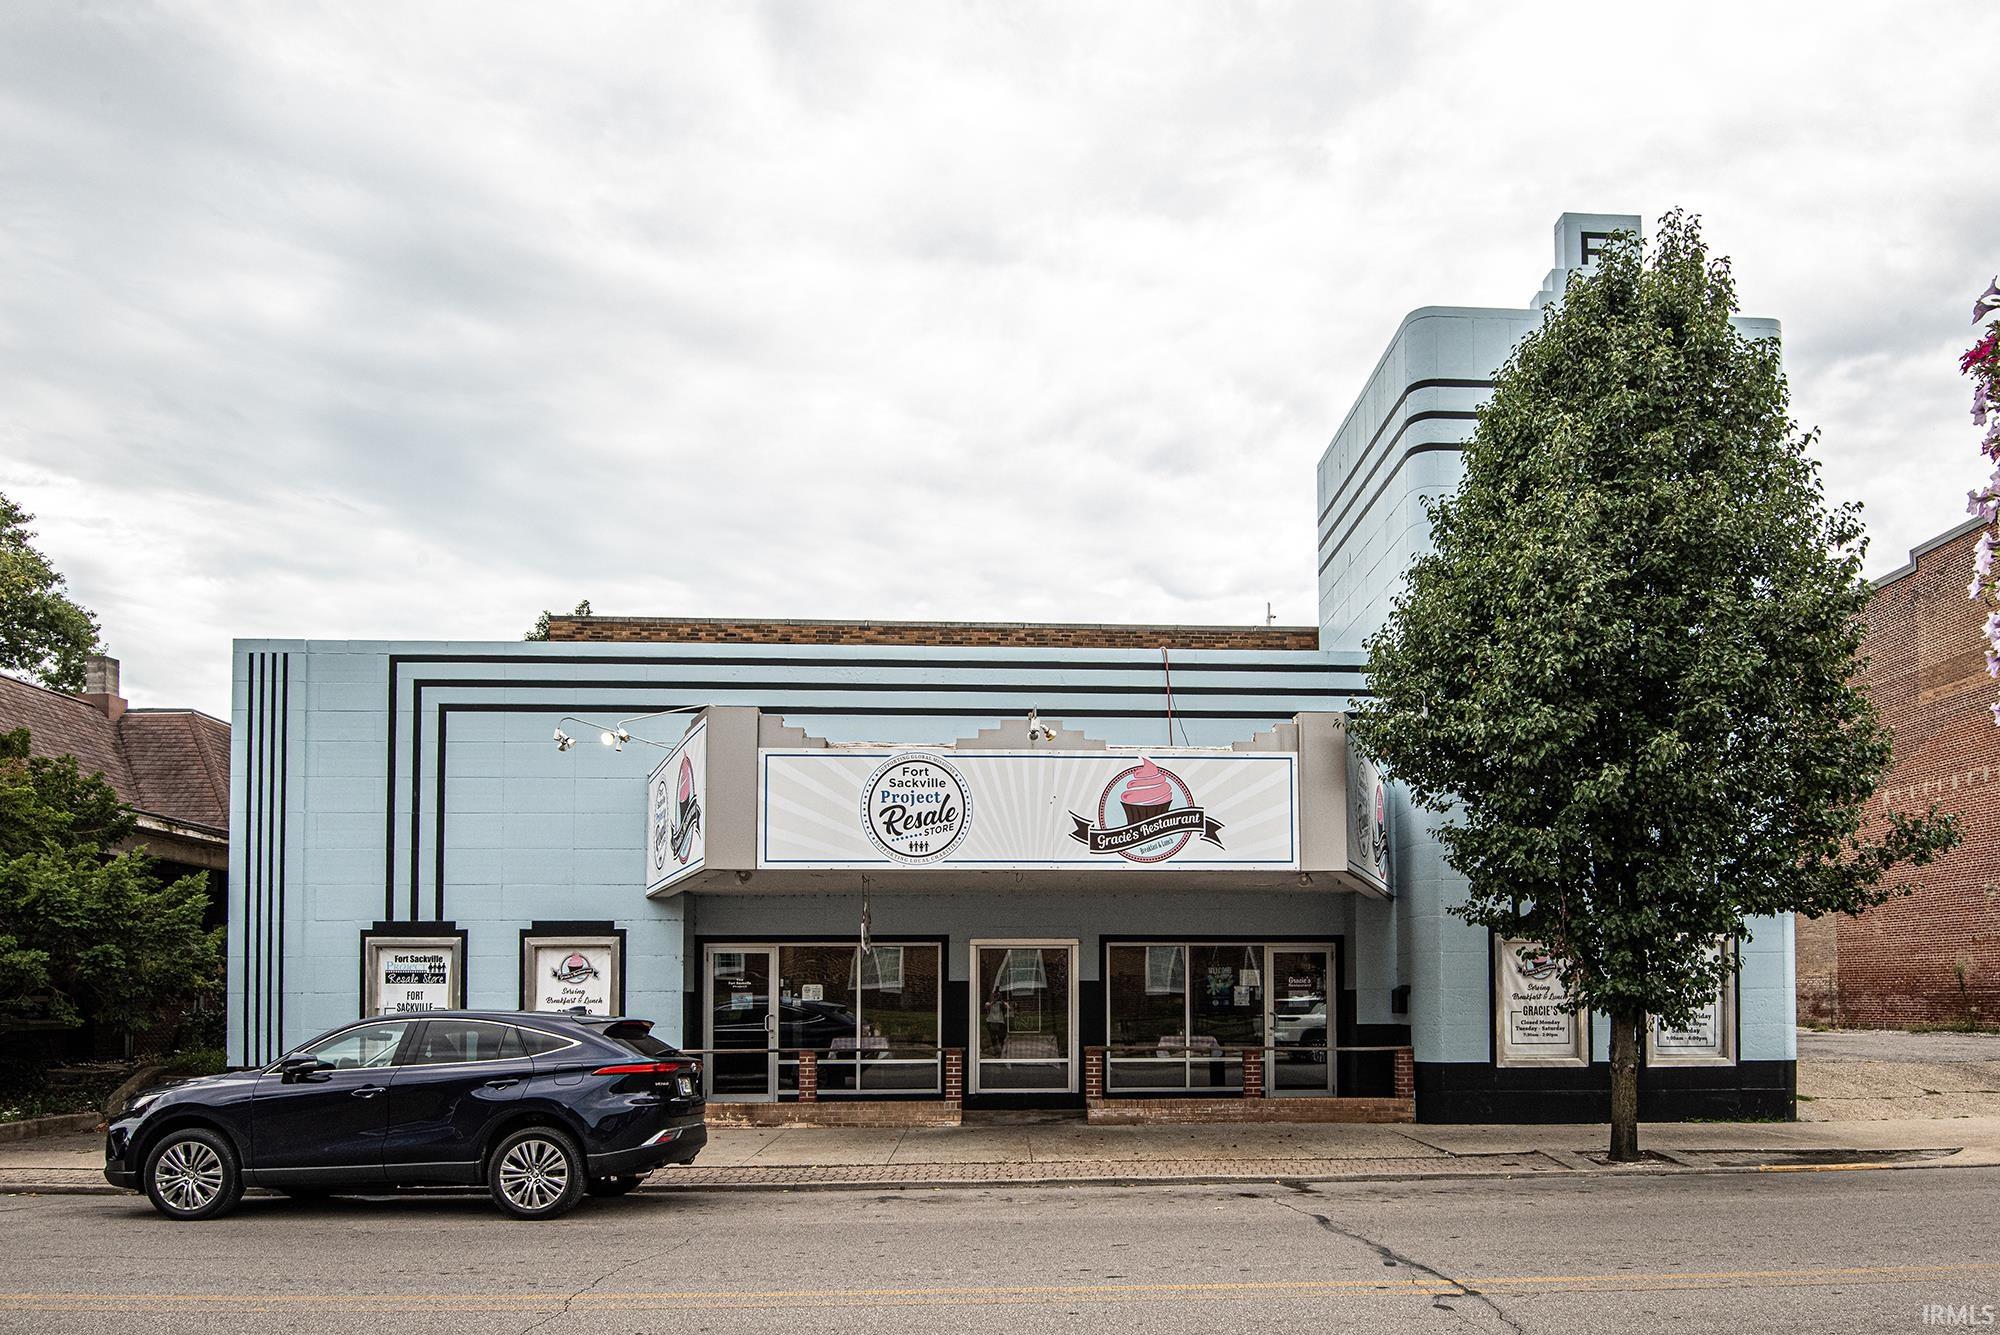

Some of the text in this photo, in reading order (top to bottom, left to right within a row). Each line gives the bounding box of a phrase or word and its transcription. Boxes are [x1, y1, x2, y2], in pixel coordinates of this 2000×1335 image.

[878, 754, 910, 773] SUPPORTING
[902, 766, 929, 777] Fort
[889, 778, 947, 788] Sackville
[880, 790, 941, 807] Project
[879, 793, 959, 836] Resale
[924, 823, 955, 837] STORE
[1097, 812, 1201, 850] Gracie's Restaurant
[874, 839, 908, 863] SUPPORTING
[930, 840, 960, 861] CHARITIES
[394, 955, 444, 963] Fort Sackville
[387, 973, 444, 984] Resale Store
[561, 987, 586, 998] Serving
[1527, 983, 1551, 994] Serving
[406, 991, 424, 1001] FORT
[546, 996, 576, 1005] Breakfast
[583, 997, 603, 1005] Lunch
[1512, 992, 1543, 1001] Breakfast
[396, 1002, 433, 1012] SACKVILLE
[1522, 1005, 1559, 1016] GRACIE'S
